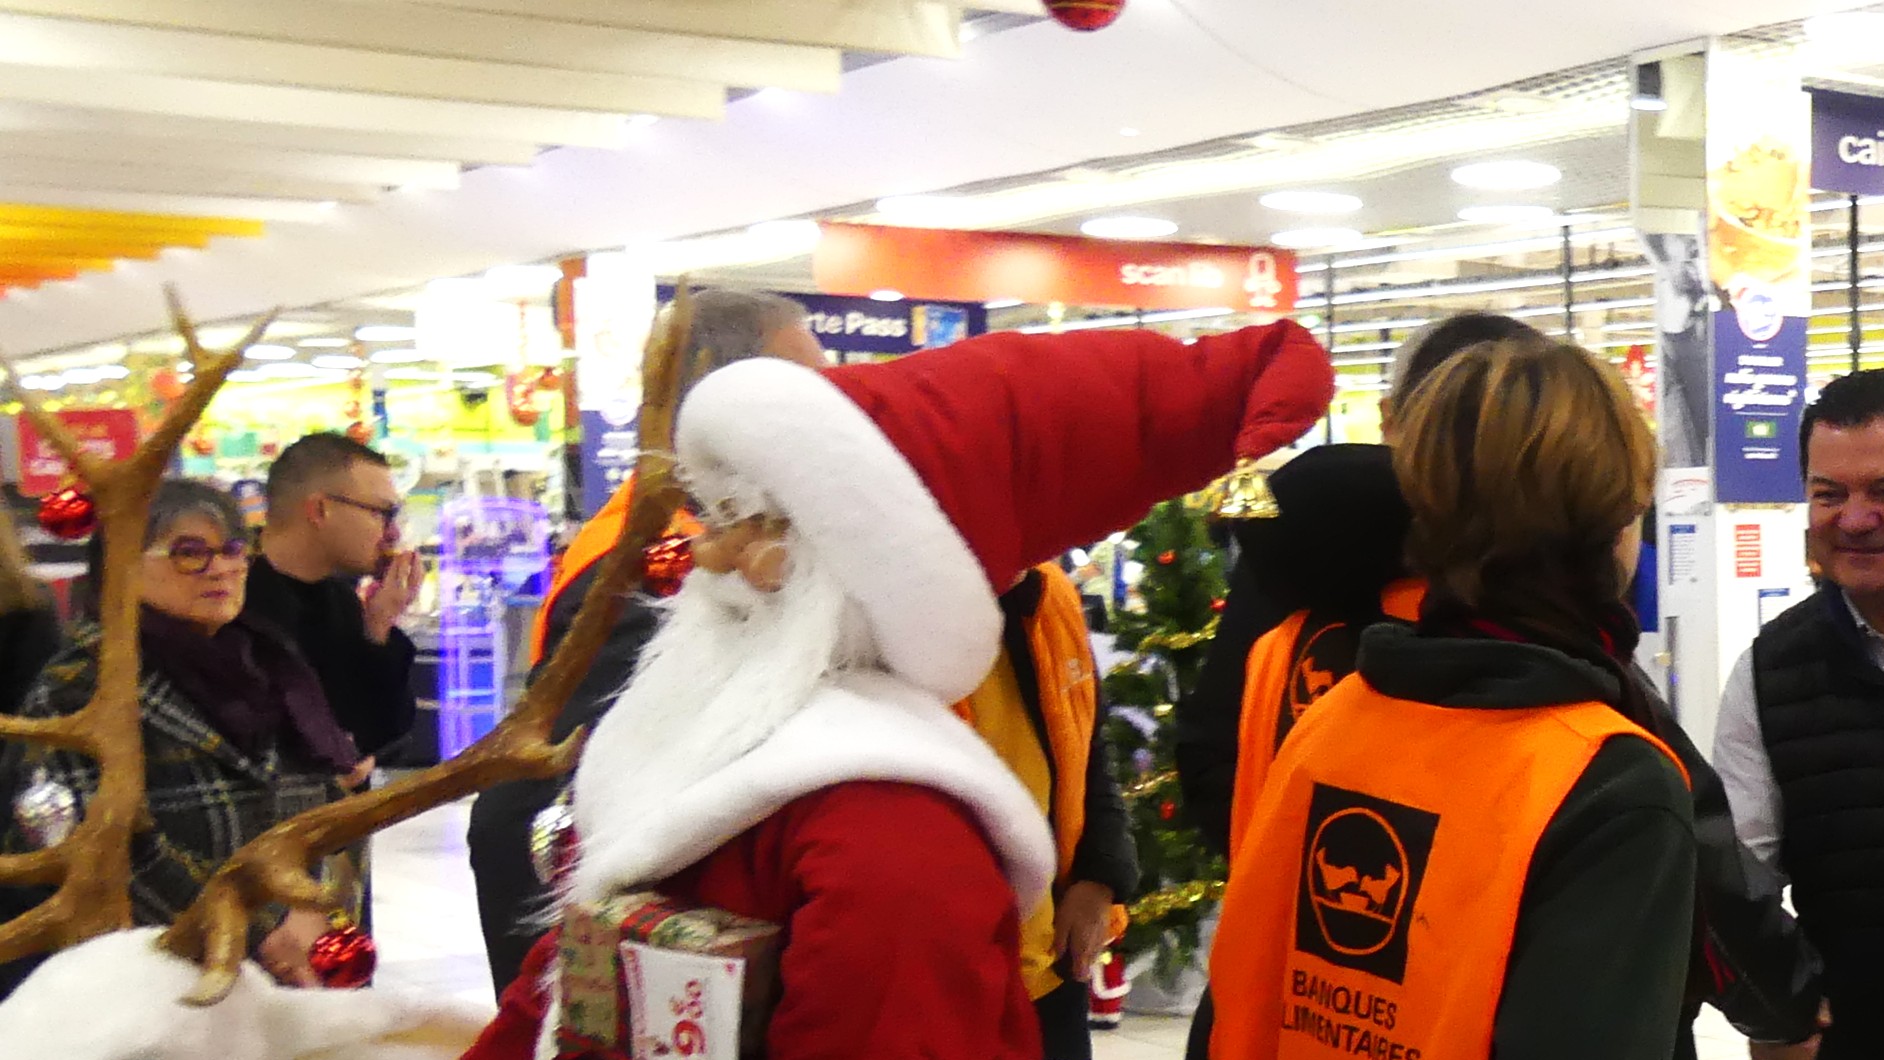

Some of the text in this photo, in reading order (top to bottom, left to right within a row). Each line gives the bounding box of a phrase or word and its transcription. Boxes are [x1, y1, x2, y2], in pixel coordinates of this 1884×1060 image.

[806, 311, 908, 338] rte Pass
[1293, 969, 1397, 1031] BANQUES
